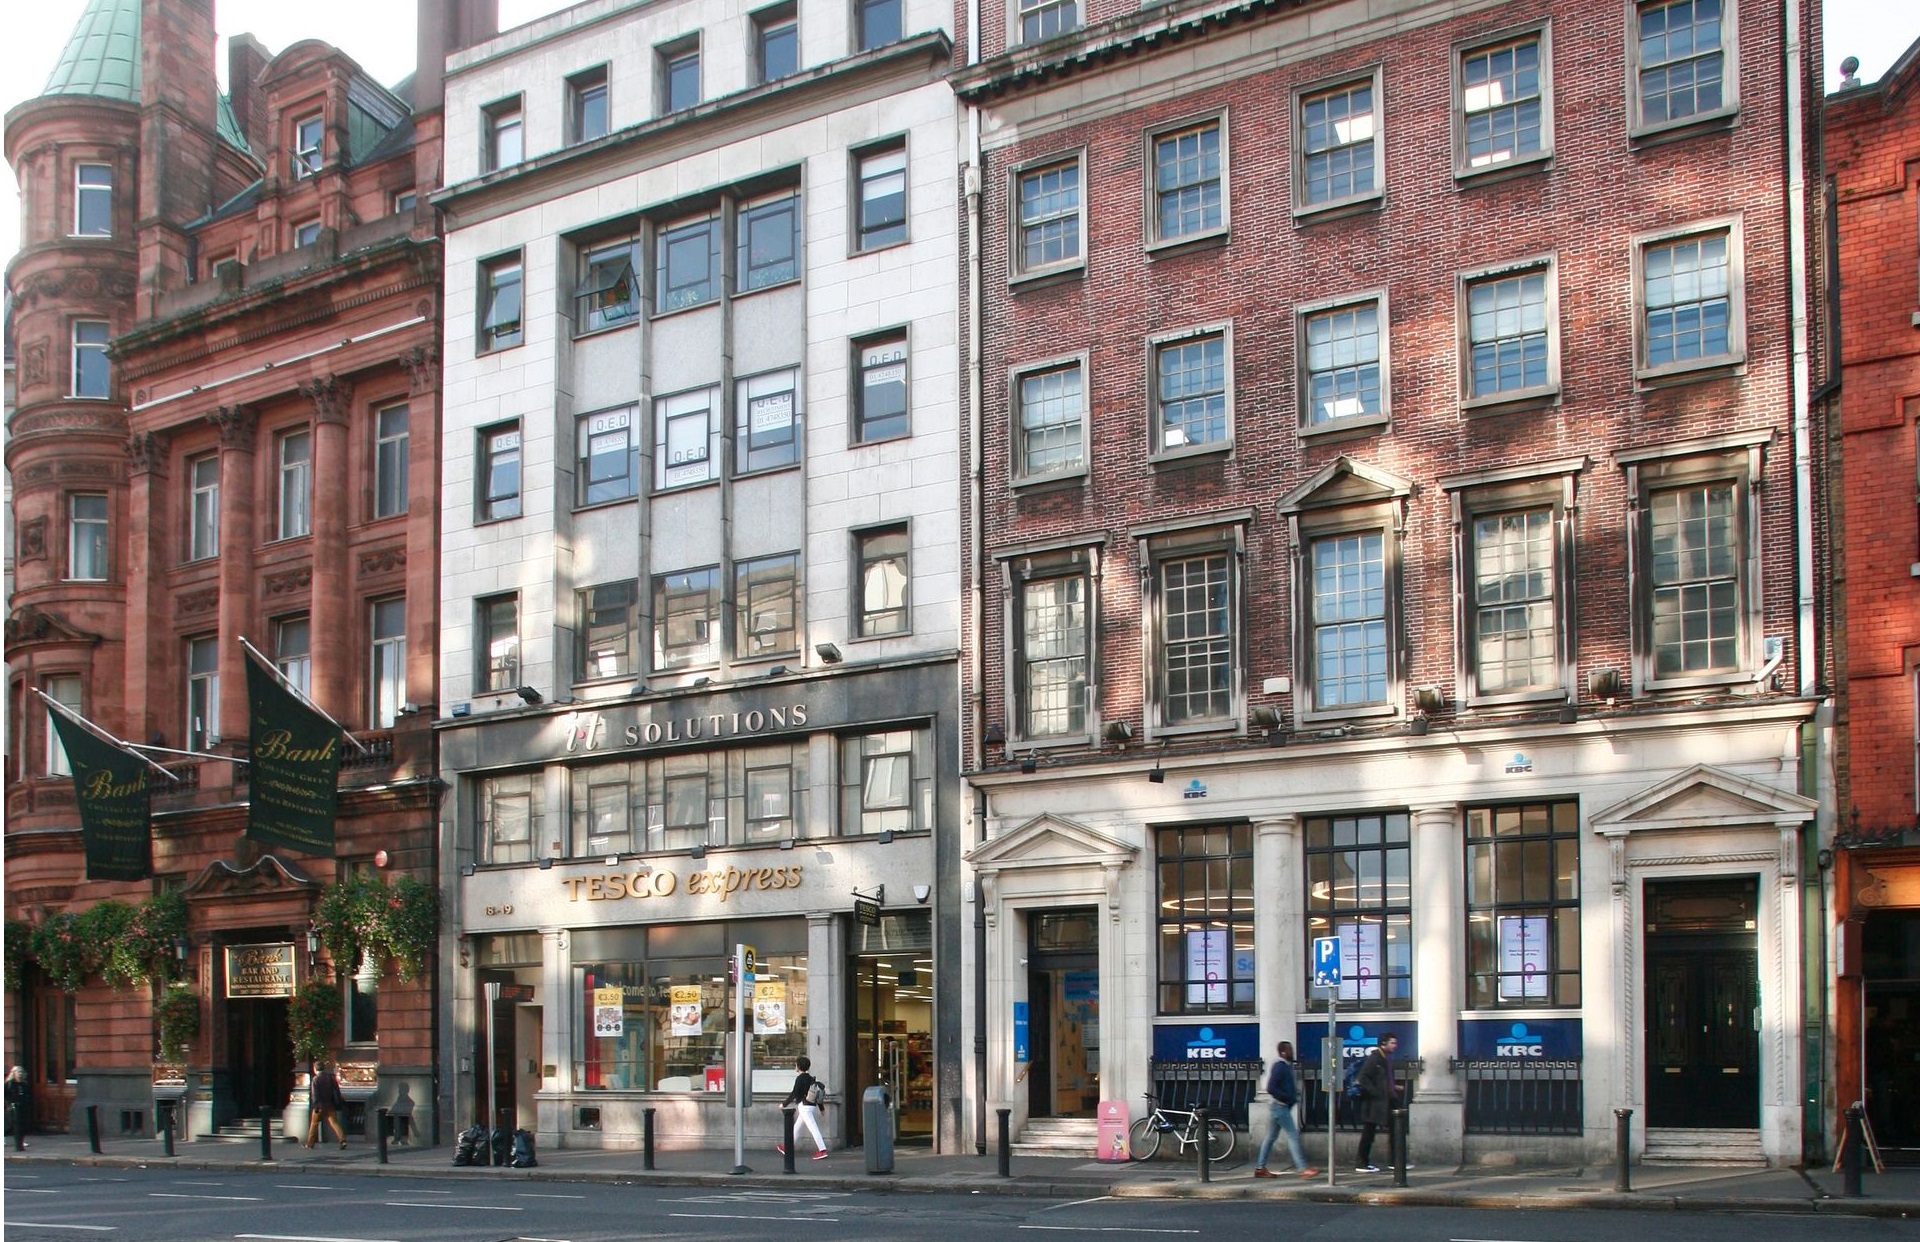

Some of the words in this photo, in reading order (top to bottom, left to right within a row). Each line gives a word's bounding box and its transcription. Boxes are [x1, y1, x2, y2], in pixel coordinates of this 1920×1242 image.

[625, 704, 807, 746] SOLUTIONS
[254, 729, 336, 761] Bank
[1506, 765, 1532, 774] KBC
[82, 768, 147, 799] Bank
[1183, 791, 1207, 799] KBC
[562, 869, 676, 902] TESCO
[685, 864, 803, 903] express
[485, 904, 514, 916] 18-19
[1321, 941, 1334, 963] P
[260, 966, 279, 975] AND
[232, 975, 290, 984] RESTAURANT
[761, 986, 775, 996] €2
[1187, 1047, 1226, 1059] KBC
